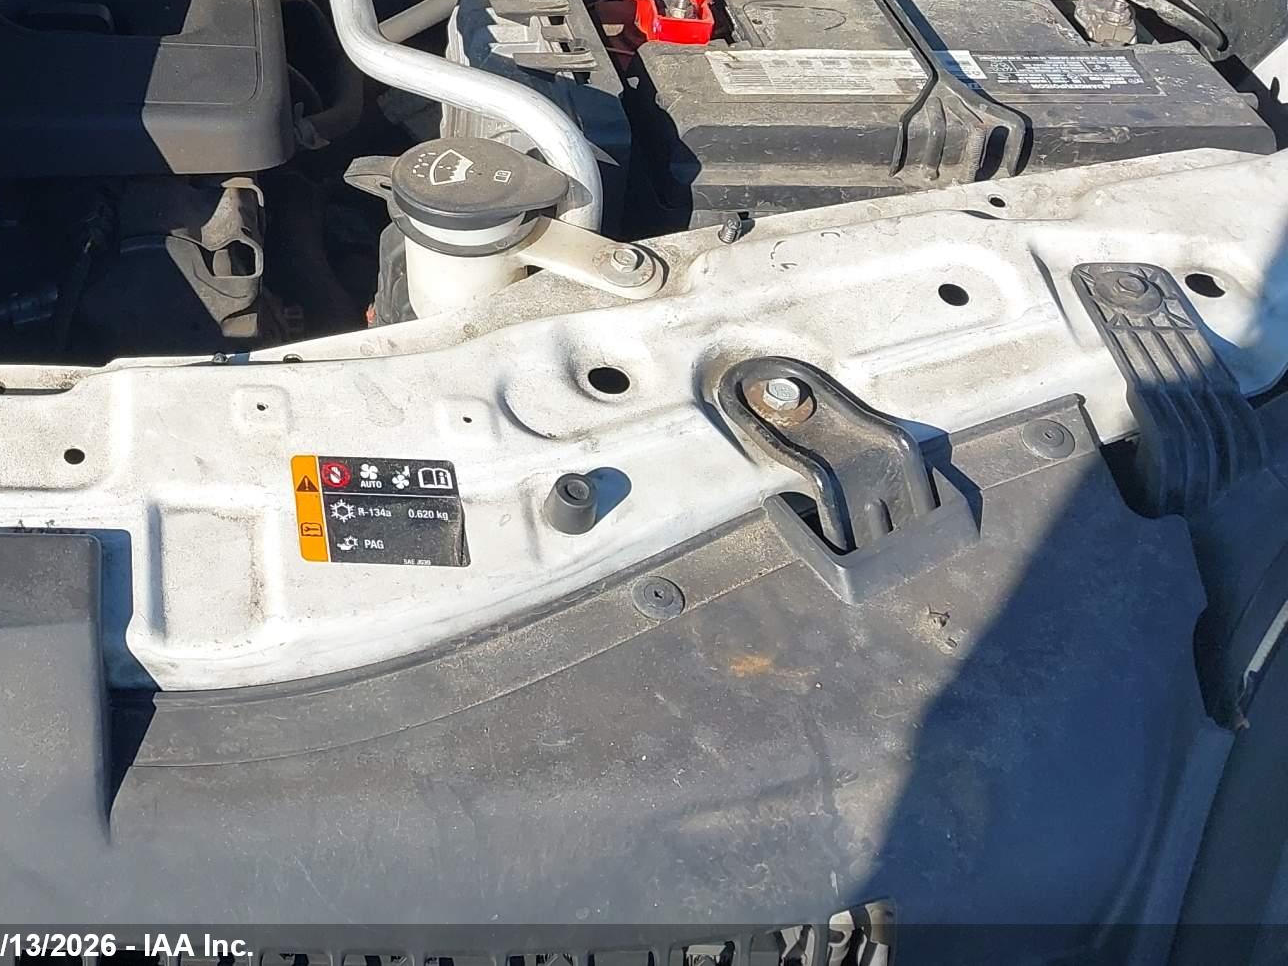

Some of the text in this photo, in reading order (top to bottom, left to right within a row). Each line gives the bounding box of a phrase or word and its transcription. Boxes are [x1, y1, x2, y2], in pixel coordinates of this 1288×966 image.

[360, 479, 382, 489] AUTO
[357, 507, 449, 521] R-134a 0.620 kg
[364, 538, 385, 550] PAG
